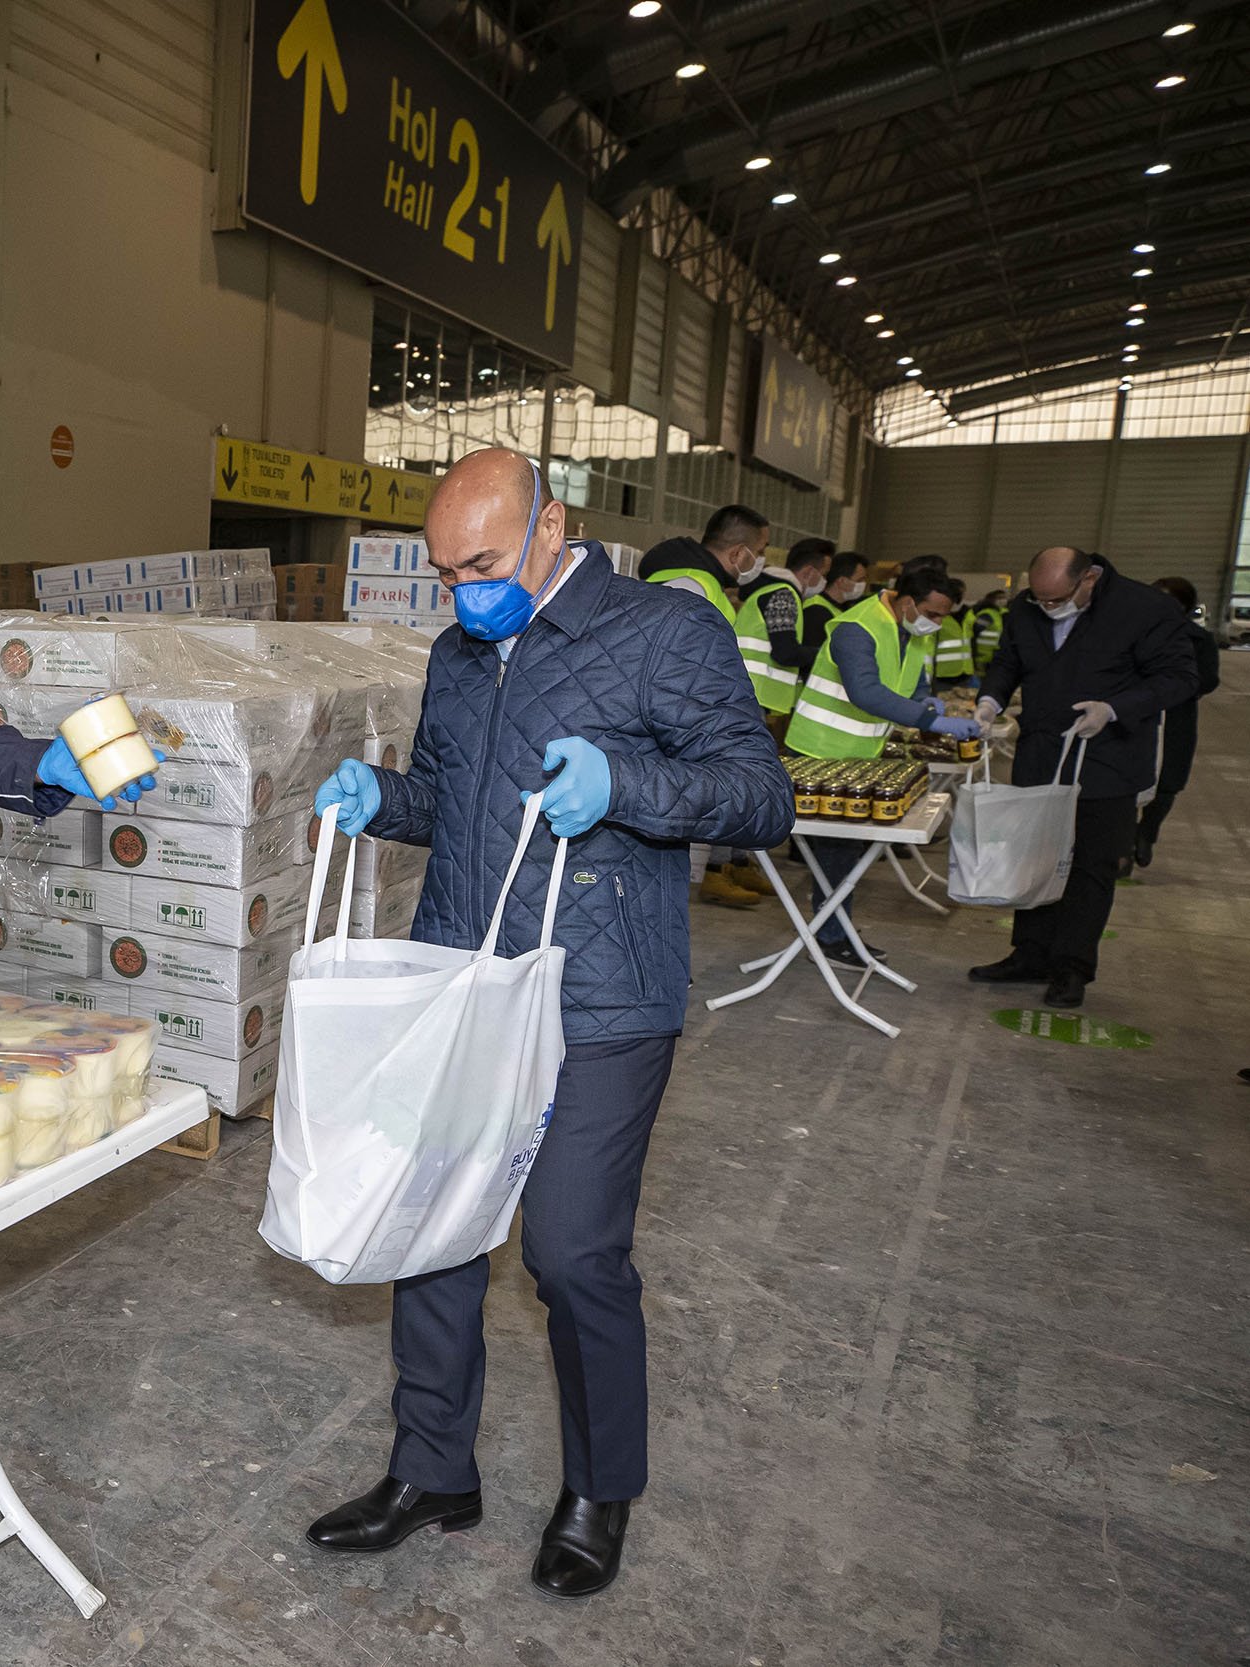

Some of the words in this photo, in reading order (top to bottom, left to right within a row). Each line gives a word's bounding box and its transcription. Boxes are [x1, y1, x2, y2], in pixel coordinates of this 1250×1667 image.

[389, 76, 437, 168] Hol
[384, 160, 434, 231] Hall
[442, 118, 510, 265] 2-1
[259, 465, 285, 480] TOILETS
[340, 467, 356, 489] Hol
[359, 469, 372, 513] 2
[338, 491, 355, 509] Hall
[371, 588, 410, 604] TARİŞ
